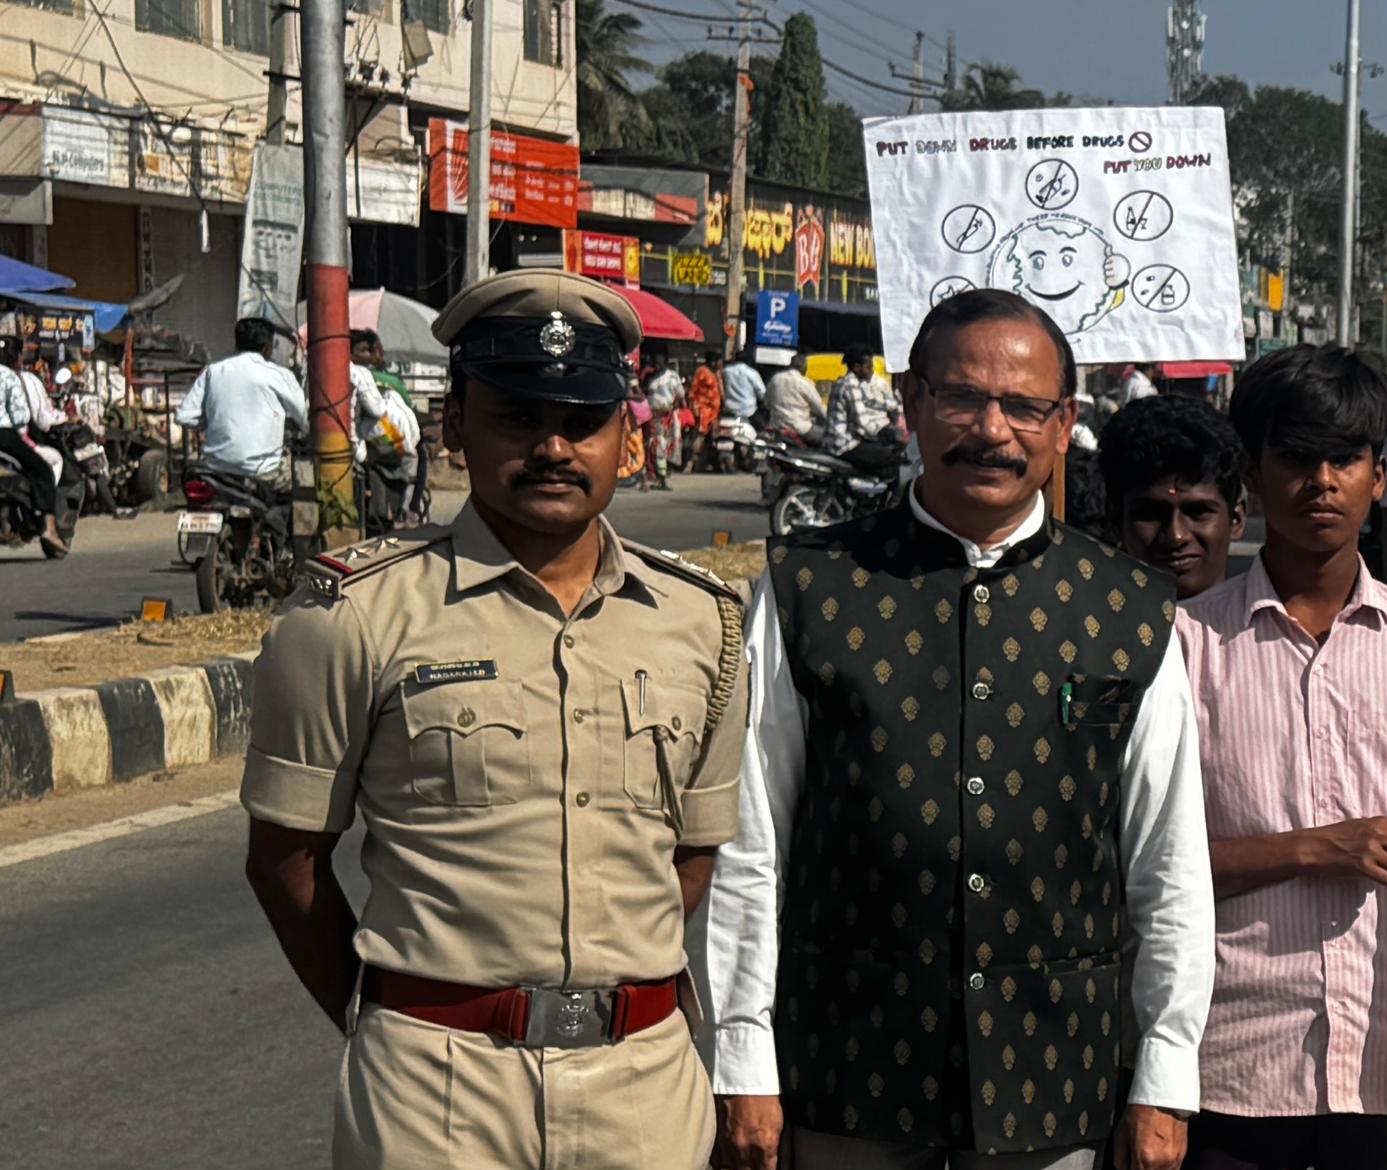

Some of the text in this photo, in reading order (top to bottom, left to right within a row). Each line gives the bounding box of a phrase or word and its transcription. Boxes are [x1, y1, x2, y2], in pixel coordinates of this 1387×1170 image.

[876, 134, 1125, 156] PUT DOWN DRUGS BEFORE DRUGS
[1103, 152, 1212, 174] PUT YOU DOWN
[770, 297, 786, 319] P
